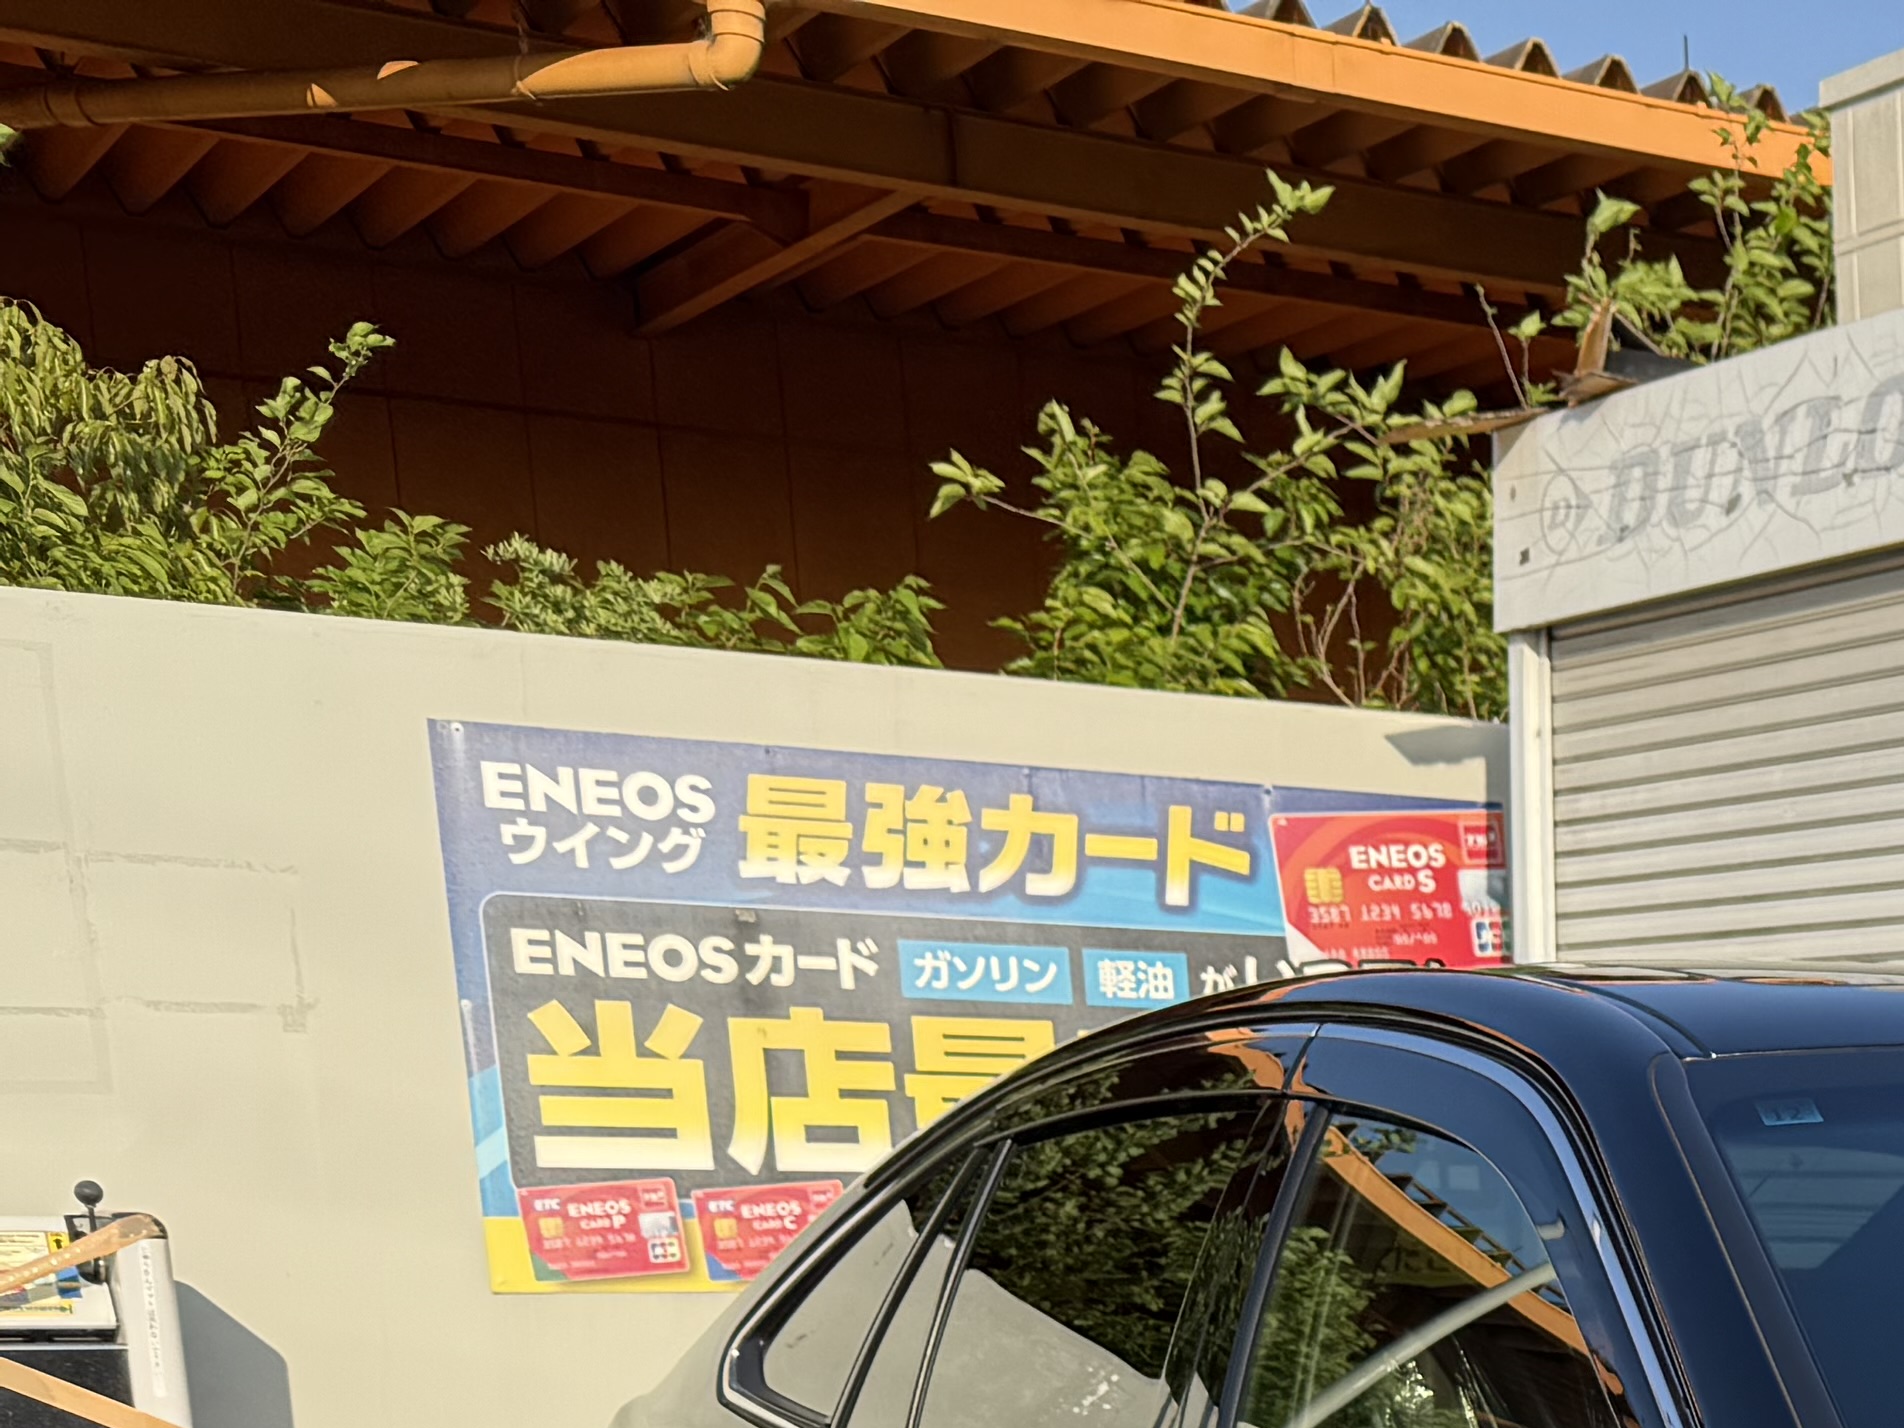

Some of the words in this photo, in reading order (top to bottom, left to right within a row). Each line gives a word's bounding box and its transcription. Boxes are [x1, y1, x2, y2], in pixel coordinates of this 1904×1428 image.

[480, 760, 716, 823] ENEOS
[500, 817, 706, 874] ウイング
[738, 773, 1251, 907] 最強カード
[1349, 843, 1446, 869] ENEOS
[1368, 873, 1416, 892] CARD
[1417, 869, 1437, 894] S
[510, 928, 879, 990] ENEOSカード
[914, 950, 1057, 993] ガソリン
[1098, 959, 1174, 999] 軽油
[534, 1199, 560, 1211] ETC
[567, 1199, 632, 1217] ENEOS
[708, 1200, 734, 1212] ETC
[741, 1201, 801, 1218] ENEOS
